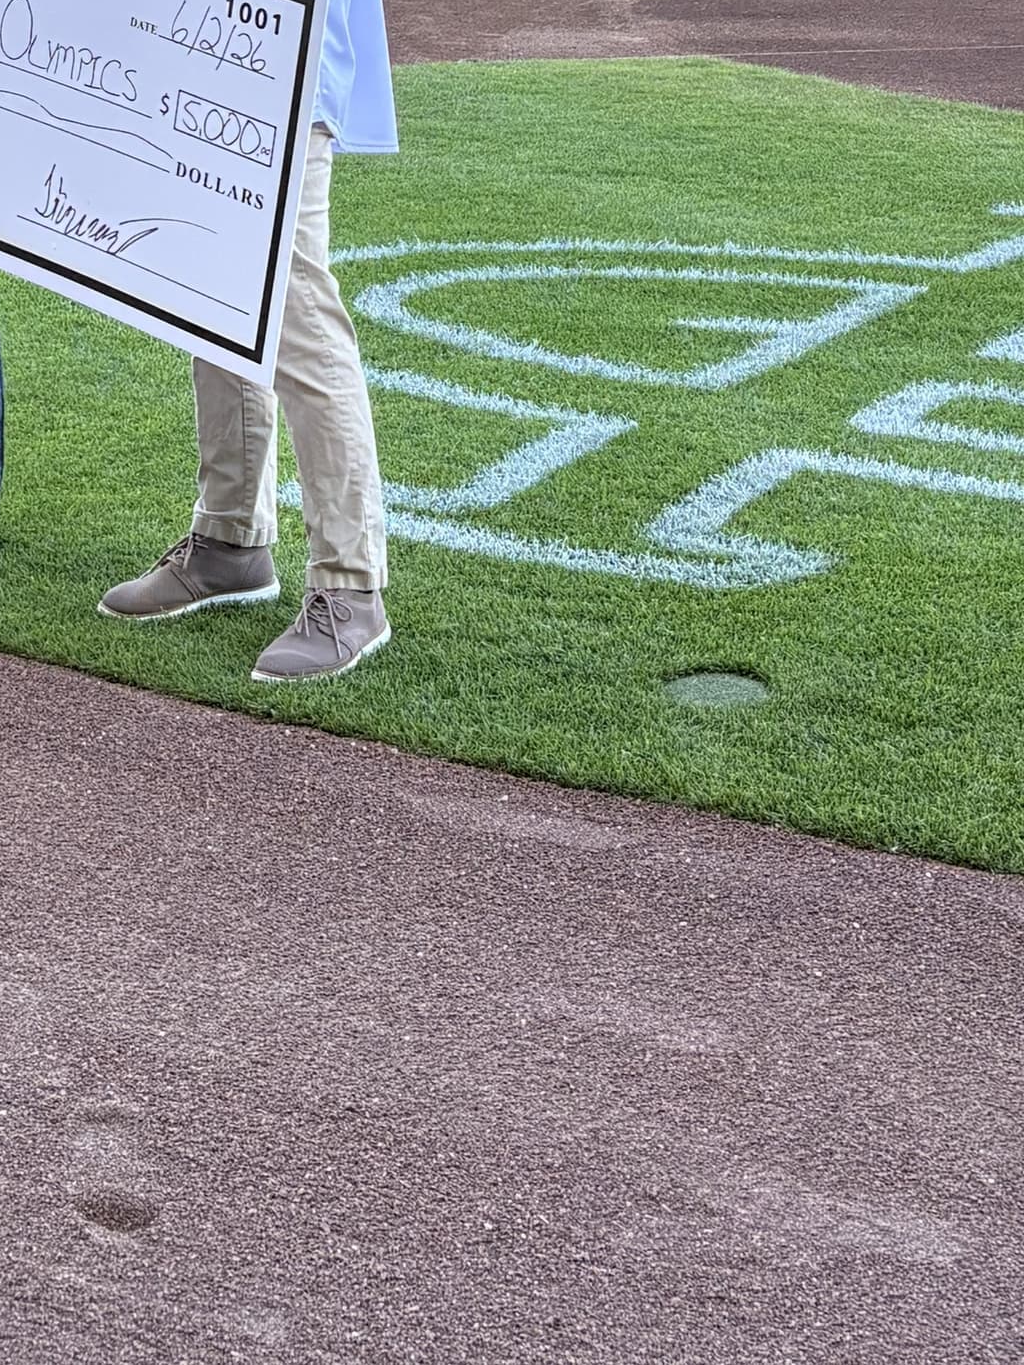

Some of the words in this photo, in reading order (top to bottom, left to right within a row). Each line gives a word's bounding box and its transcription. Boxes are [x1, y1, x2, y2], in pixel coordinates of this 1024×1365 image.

[129, 17, 159, 35] DATE
[171, 0, 266, 73] 6/2/26
[159, 93, 170, 115] $
[175, 161, 264, 210] DOLLARS
